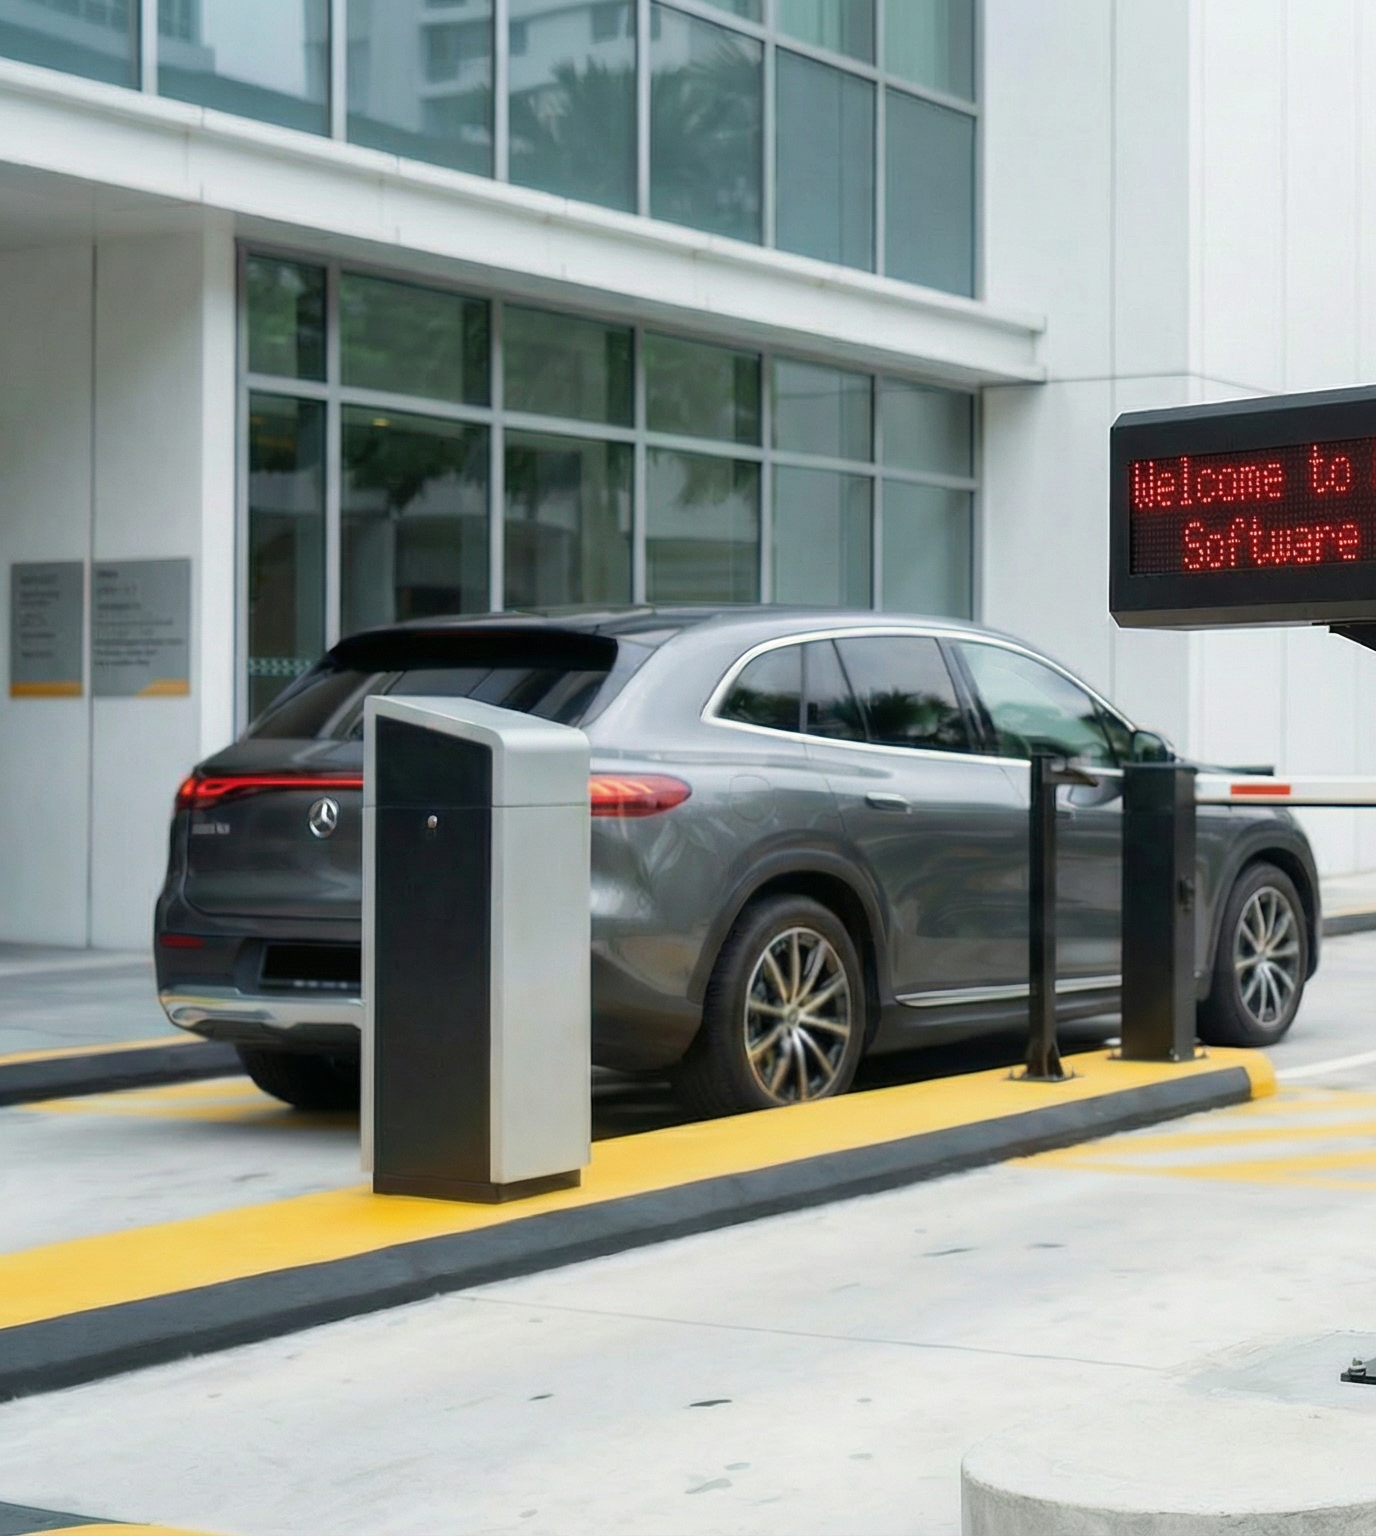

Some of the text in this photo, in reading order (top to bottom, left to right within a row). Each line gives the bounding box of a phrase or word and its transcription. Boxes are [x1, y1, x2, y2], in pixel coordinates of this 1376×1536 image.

[1133, 455, 1284, 510] Welcome
[1308, 443, 1353, 494] to
[1183, 515, 1359, 570] Software
